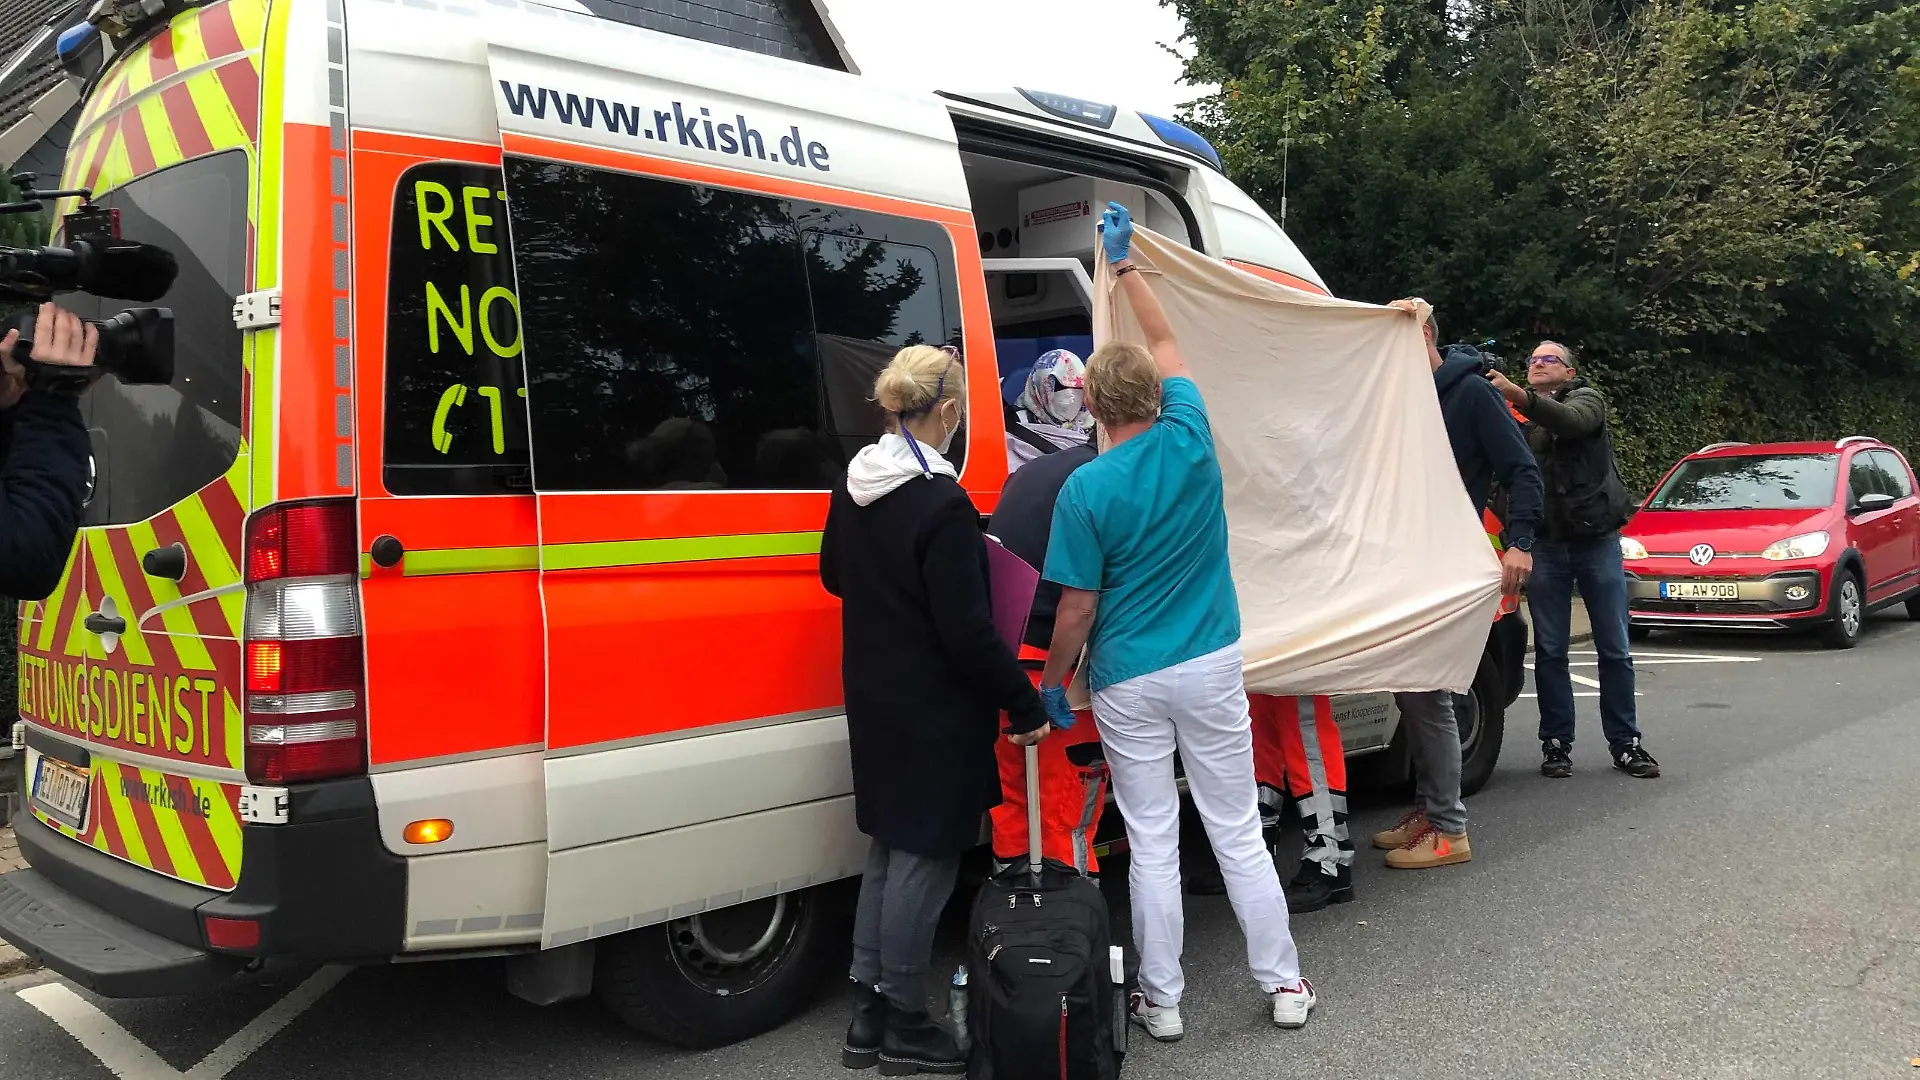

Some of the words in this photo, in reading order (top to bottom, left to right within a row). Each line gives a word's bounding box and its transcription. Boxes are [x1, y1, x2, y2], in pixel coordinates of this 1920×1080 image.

[499, 79, 831, 172] www.rkish.de
[415, 180, 507, 254] RE
[1669, 584, 1684, 596] PI
[1692, 585, 1708, 596] AW
[1710, 585, 1735, 597] 908
[18, 650, 217, 757] RETTUNGSDIENST
